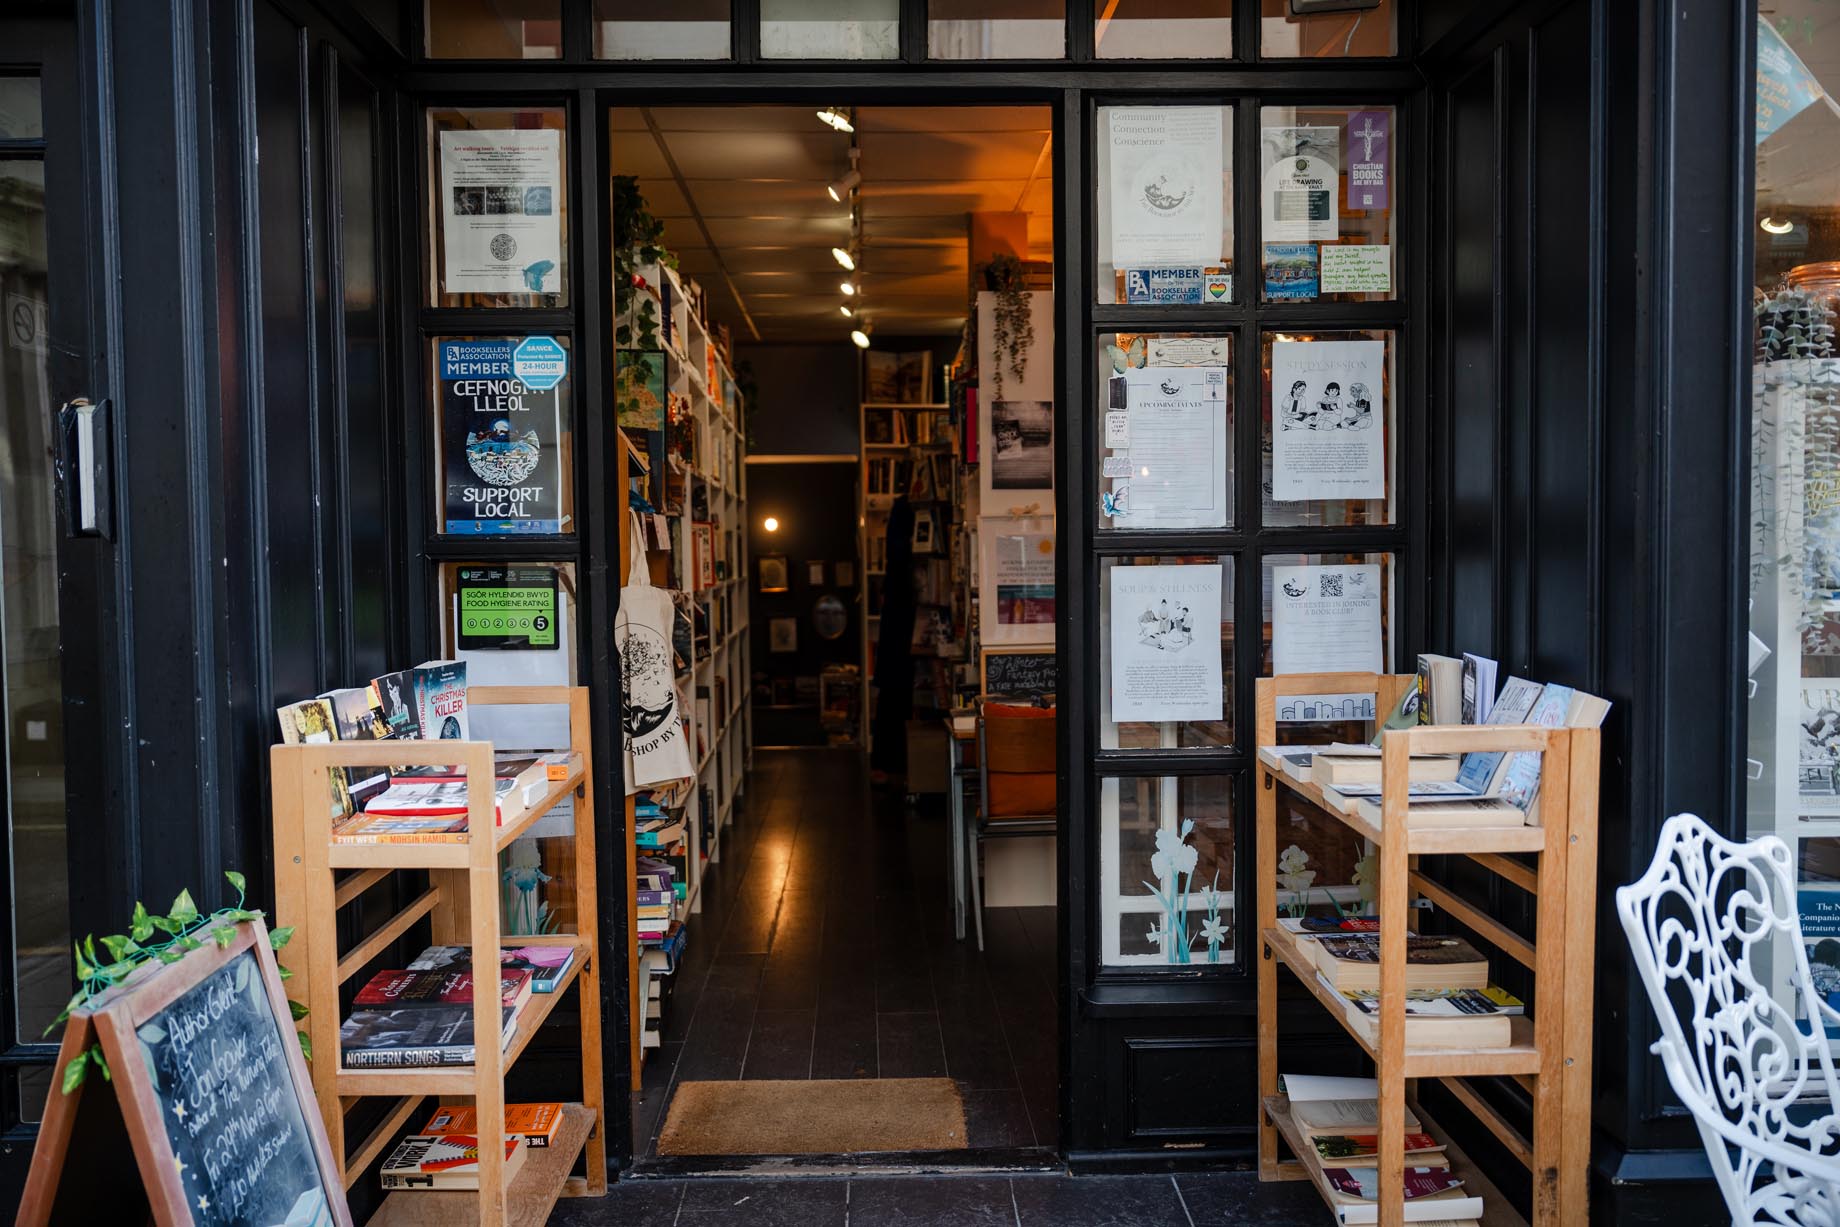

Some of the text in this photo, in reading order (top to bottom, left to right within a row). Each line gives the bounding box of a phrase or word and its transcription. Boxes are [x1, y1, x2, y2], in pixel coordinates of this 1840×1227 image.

[1112, 112, 1167, 124] Community
[1113, 125, 1165, 134] Connection
[1114, 137, 1165, 146] Conscience
[1352, 170, 1384, 179] BOOKS
[1152, 270, 1200, 279] MEMBER
[447, 363, 510, 375] MEMBER
[1324, 360, 1368, 369] SESSION
[474, 396, 530, 412] LLEOL
[462, 488, 543, 502] SUPPORT
[475, 503, 531, 518] LOCAL
[536, 618, 545, 629] 5
[431, 688, 466, 704] CHRISTMAS
[434, 700, 463, 718] KILLER
[660, 727, 675, 742] BY
[336, 836, 354, 844] EXIT
[389, 835, 420, 844] MOHSIN
[422, 834, 447, 843] HAMID
[1798, 913, 1840, 923] Companio
[168, 1005, 210, 1054] Author
[346, 1050, 440, 1066] NORTHERN SONGS
[184, 1052, 217, 1108] Jon
[219, 1081, 241, 1110] The
[531, 1137, 545, 1146] THE
[394, 1145, 432, 1169] WORK
[204, 1148, 220, 1190] Fri
